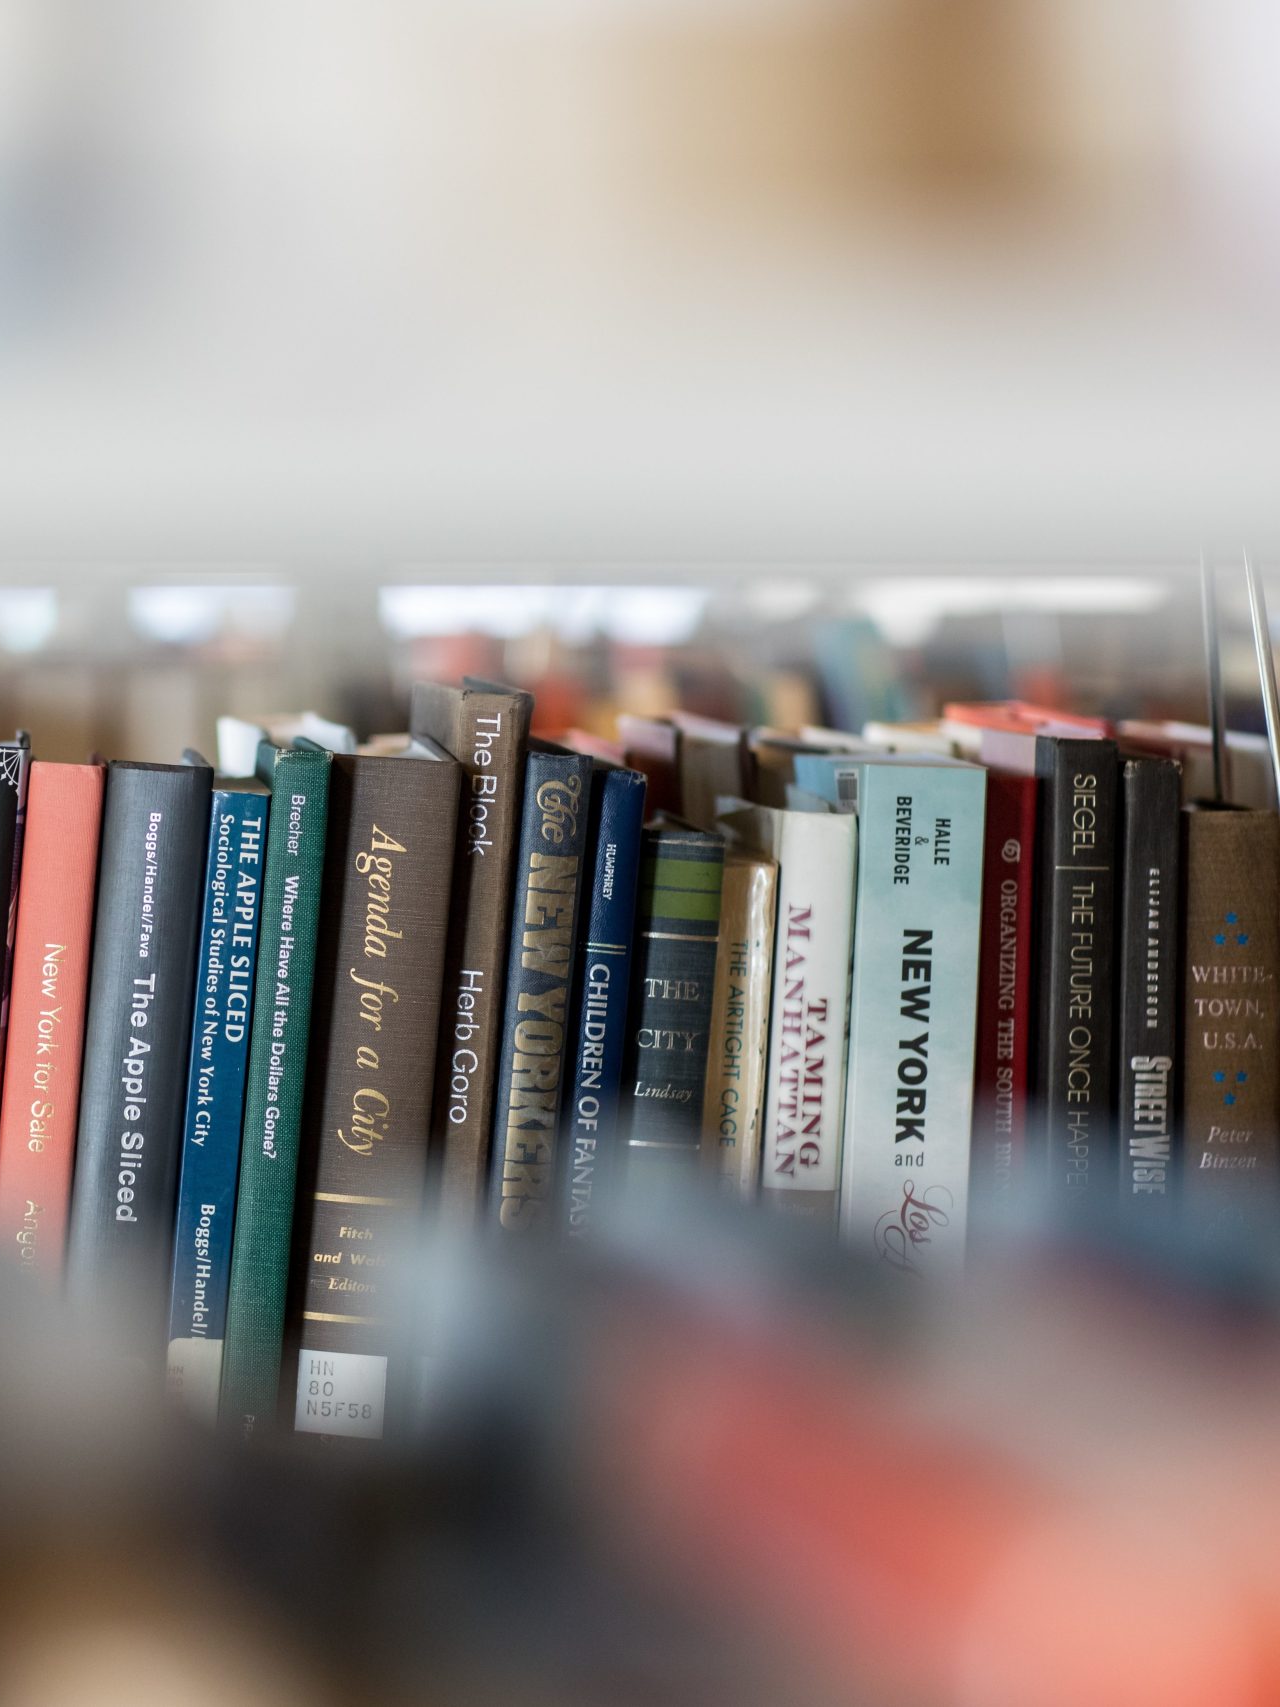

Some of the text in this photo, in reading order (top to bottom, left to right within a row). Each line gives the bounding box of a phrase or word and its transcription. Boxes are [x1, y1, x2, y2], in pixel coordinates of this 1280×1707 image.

[471, 713, 500, 857] The Block
[1073, 773, 1096, 856] SIEGEL
[287, 794, 305, 856] Brecher
[894, 796, 912, 885] BEVERIDGE
[915, 836, 929, 845] &
[934, 818, 951, 866] HALLE
[140, 812, 161, 958] Boggs/Handel/Fava
[603, 843, 616, 900] HUMPHREY
[226, 816, 261, 1043] THE APPLE SLICED
[730, 939, 748, 976] THE
[191, 814, 235, 1147] Sociological Studies of New York City
[338, 823, 407, 1156] Agenda for a City
[502, 774, 581, 1232] The NEW YORKERS
[645, 978, 700, 1000] THE
[996, 880, 1017, 1133] ORGANIZING THE SOUTH
[1068, 881, 1094, 1103] THE FUTURE ONCE
[1192, 965, 1273, 983] WHITE-
[1193, 999, 1265, 1017] TOWN,
[29, 943, 66, 1153] New York for Sale
[263, 875, 300, 1159] Where Have All the Dollars Gone?
[450, 970, 483, 1124] Herb Goro
[577, 963, 609, 1130] CHILDREN OF
[636, 1028, 700, 1051] CITY
[724, 984, 745, 1080] AIRTIGHT
[776, 903, 812, 1180] MANHATTAN
[896, 928, 933, 1144] NEW YORK
[1203, 1032, 1264, 1048] U.S.A.
[116, 973, 155, 1222] The Apple Sliced
[633, 1081, 693, 1103] Lindsay
[720, 1088, 738, 1148] CAGE
[799, 997, 827, 1169] TAMING
[894, 1152, 925, 1166] and
[1199, 1152, 1258, 1168] Binzen
[1207, 1126, 1253, 1143] Peter
[313, 1252, 342, 1263] and
[339, 1227, 373, 1239] Fitch
[308, 1381, 334, 1396] 80
[309, 1360, 334, 1376] HN
